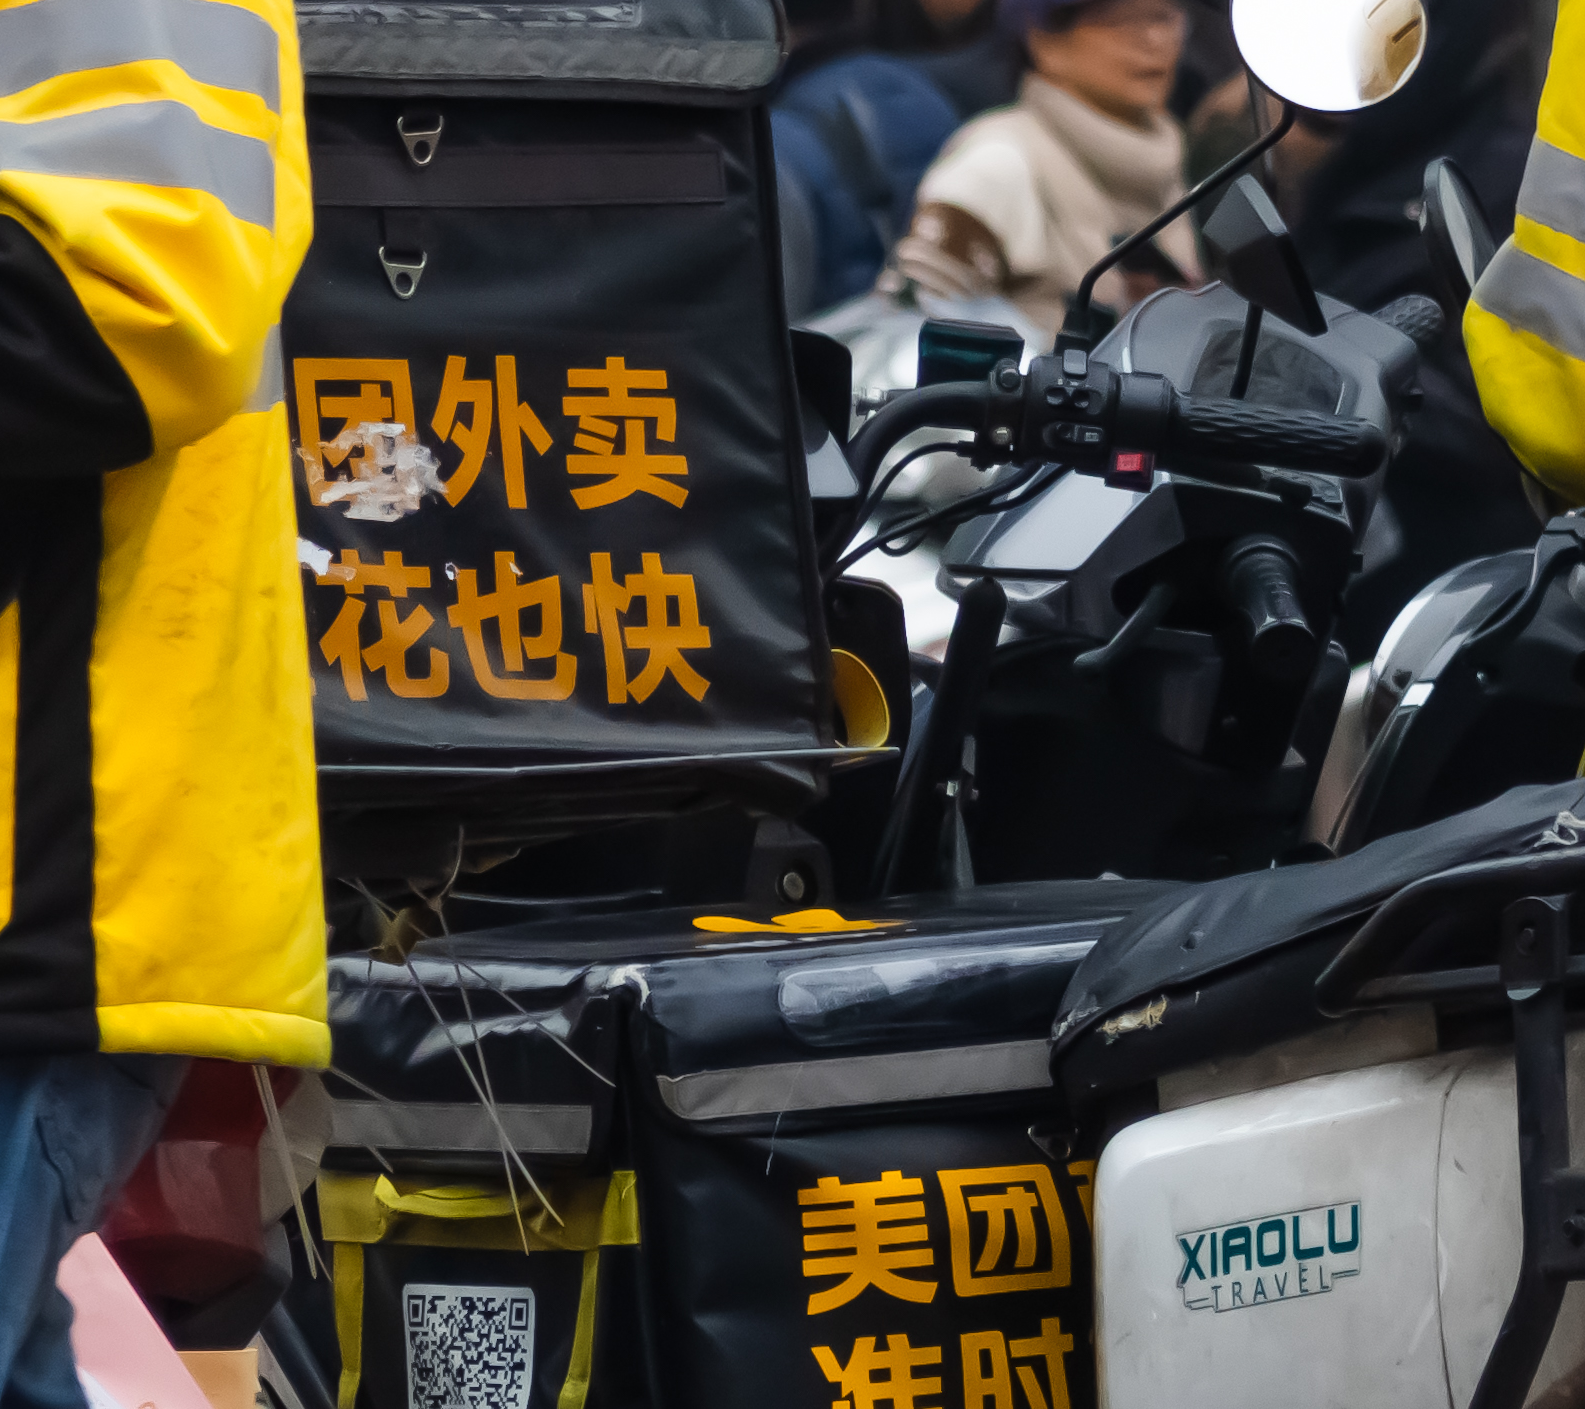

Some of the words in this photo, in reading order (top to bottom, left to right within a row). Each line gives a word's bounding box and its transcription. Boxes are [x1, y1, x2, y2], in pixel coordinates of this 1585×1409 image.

[796, 1160, 1095, 1316] 美团
[1179, 1204, 1359, 1286] XIAOLU
[1211, 1262, 1330, 1314] TRAVEL
